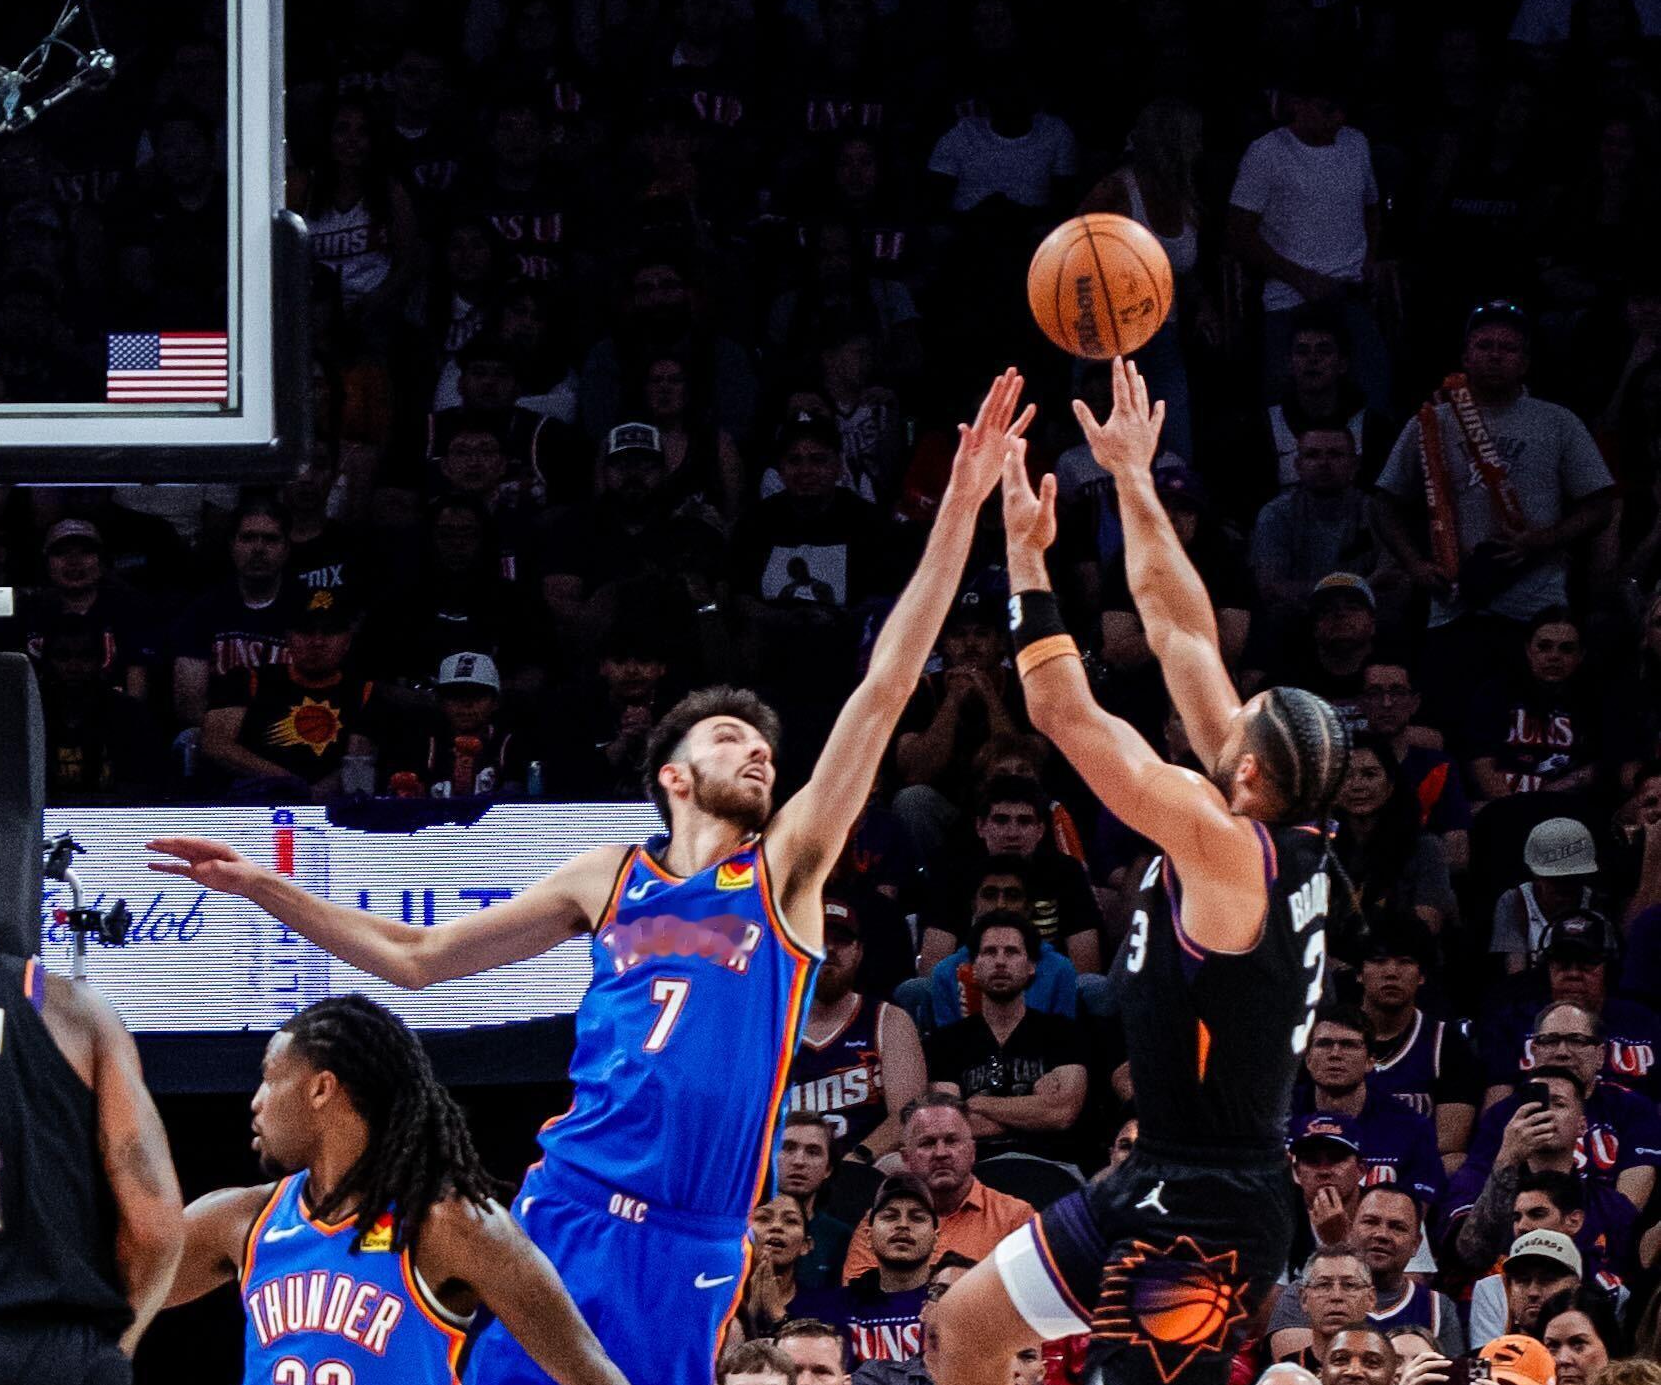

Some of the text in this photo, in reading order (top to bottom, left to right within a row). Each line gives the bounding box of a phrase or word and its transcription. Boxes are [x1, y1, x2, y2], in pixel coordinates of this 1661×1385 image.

[642, 976, 691, 1054] 7
[1608, 1043, 1653, 1077] UP
[607, 1192, 649, 1223] OKC
[248, 1269, 404, 1356] THUNDER
